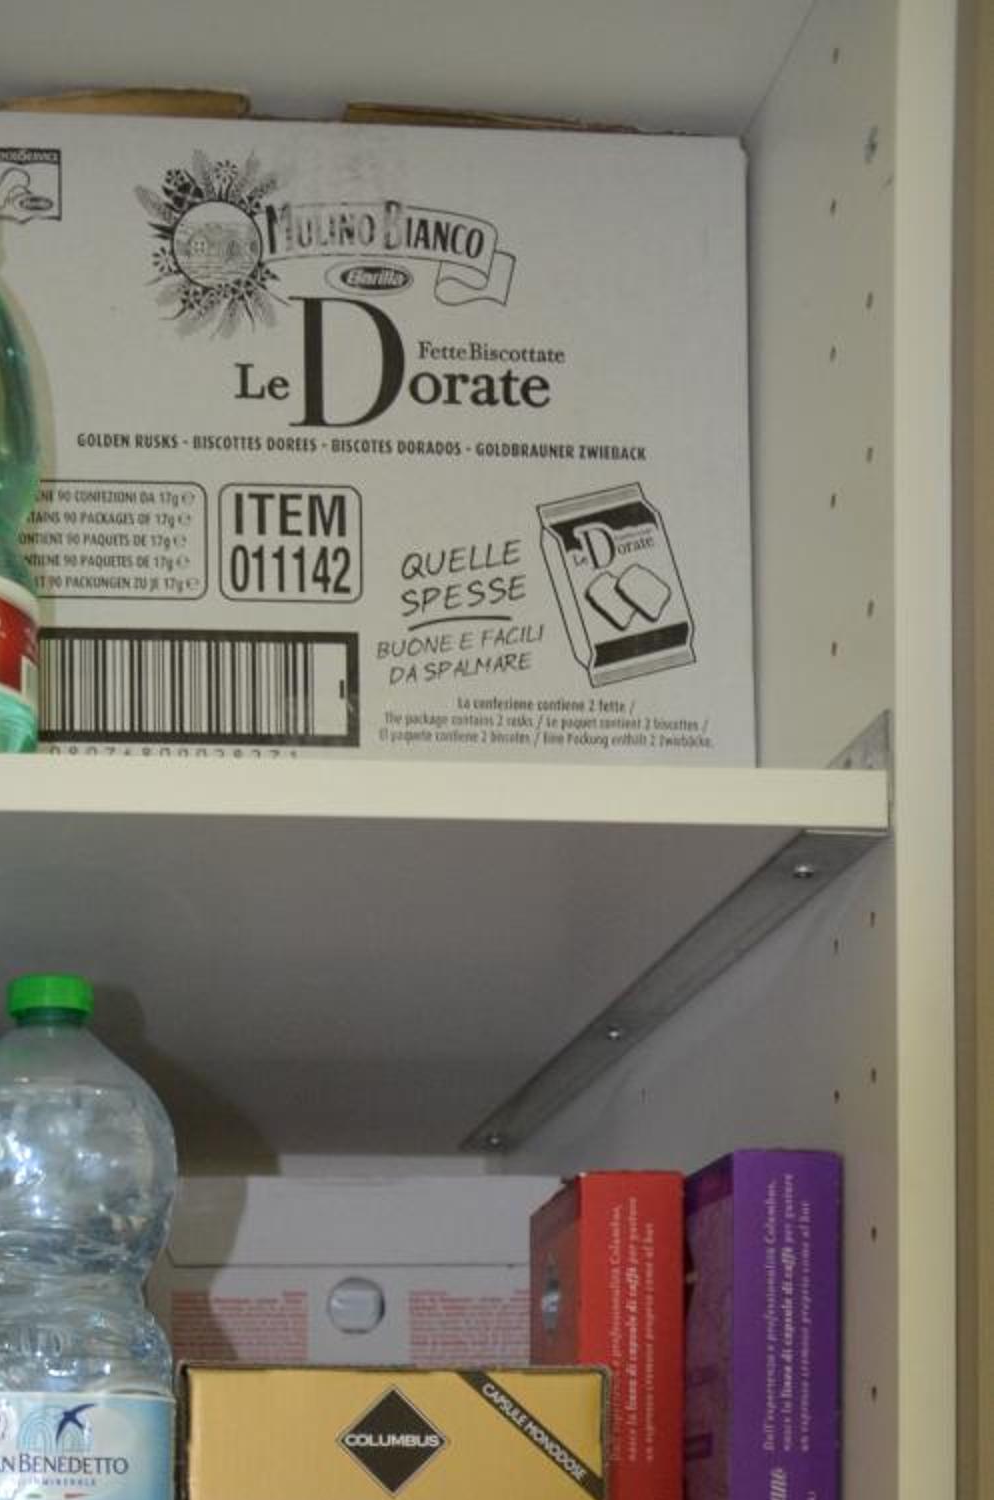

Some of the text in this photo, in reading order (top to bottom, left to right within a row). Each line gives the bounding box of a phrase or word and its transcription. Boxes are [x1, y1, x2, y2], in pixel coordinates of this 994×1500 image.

[234, 295, 552, 428] Le Dorate
[417, 340, 566, 365] Fette Biscottate
[77, 433, 130, 448] GOLDEN
[135, 433, 178, 448] RUSKS
[193, 434, 262, 450] BISCOTTES
[331, 437, 392, 454] BISCOTES
[397, 438, 461, 456] DORADOS
[476, 441, 575, 458] GOLDBRAUNER
[579, 443, 646, 461] ZWIEBACK
[234, 492, 347, 537] ITEM
[230, 544, 351, 594] 011142
[401, 539, 522, 581] QUELLE
[401, 574, 527, 617] SPESSE
[377, 623, 545, 659] BUONE E FACILI
[389, 651, 533, 686] DA SPALMARE
[344, 1432, 441, 1448] COLUMBUS
[480, 1381, 588, 1481] CAPSULE MONODOSE
